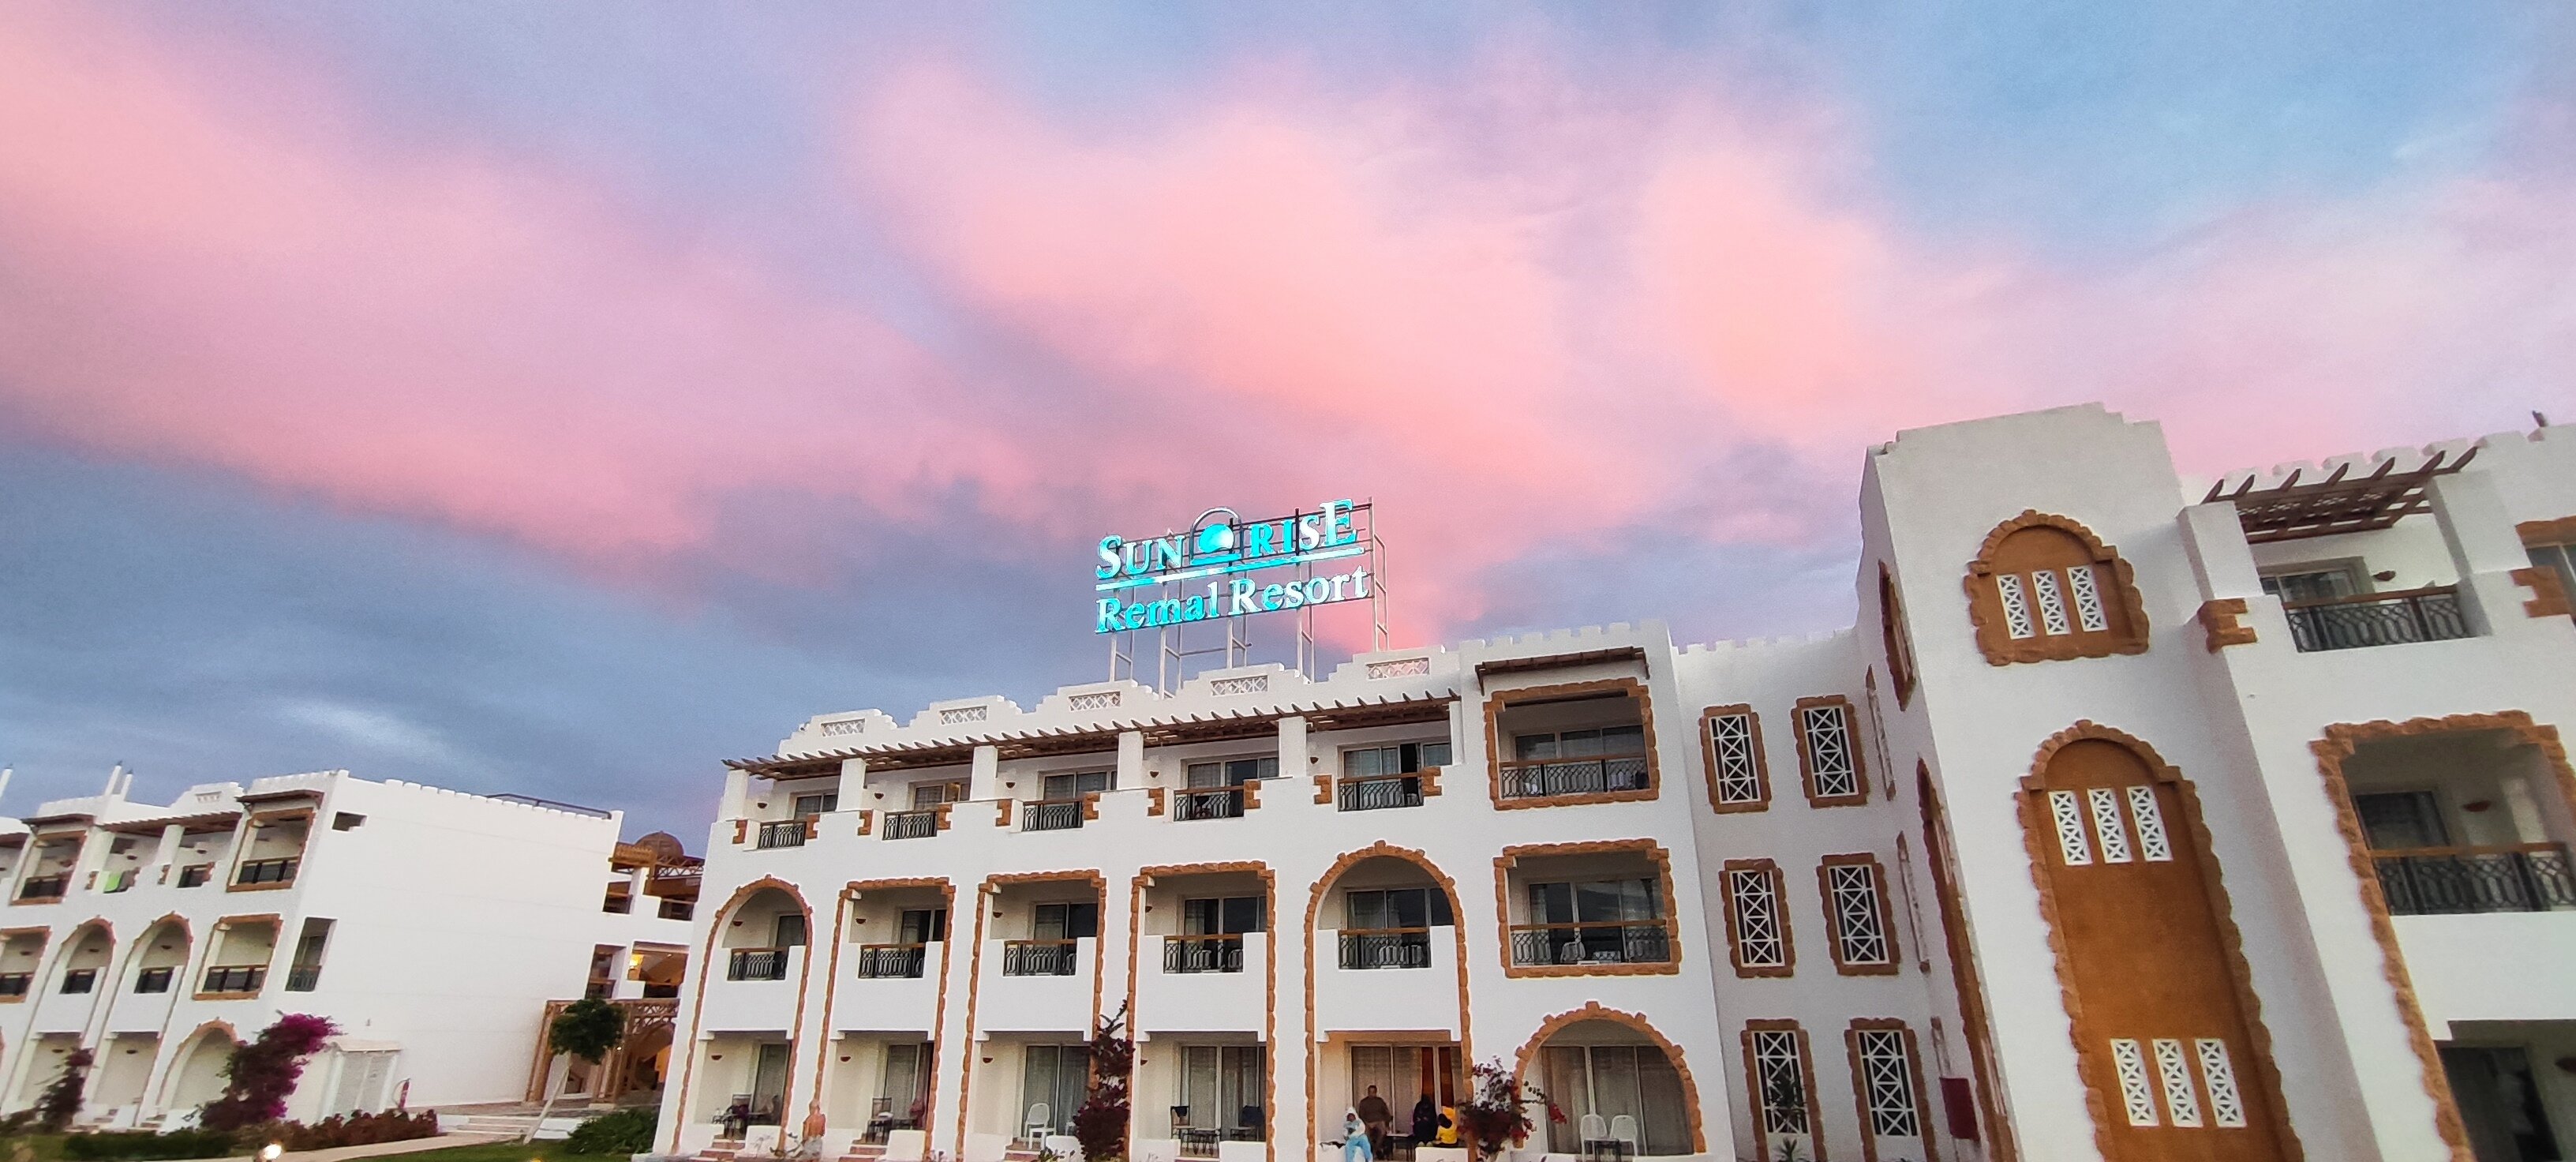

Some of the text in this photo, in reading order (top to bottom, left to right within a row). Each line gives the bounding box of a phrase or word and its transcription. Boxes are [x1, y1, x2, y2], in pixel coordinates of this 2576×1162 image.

[1095, 498, 1357, 580] SUN RISE
[1095, 565, 1370, 633] Remal Resort
